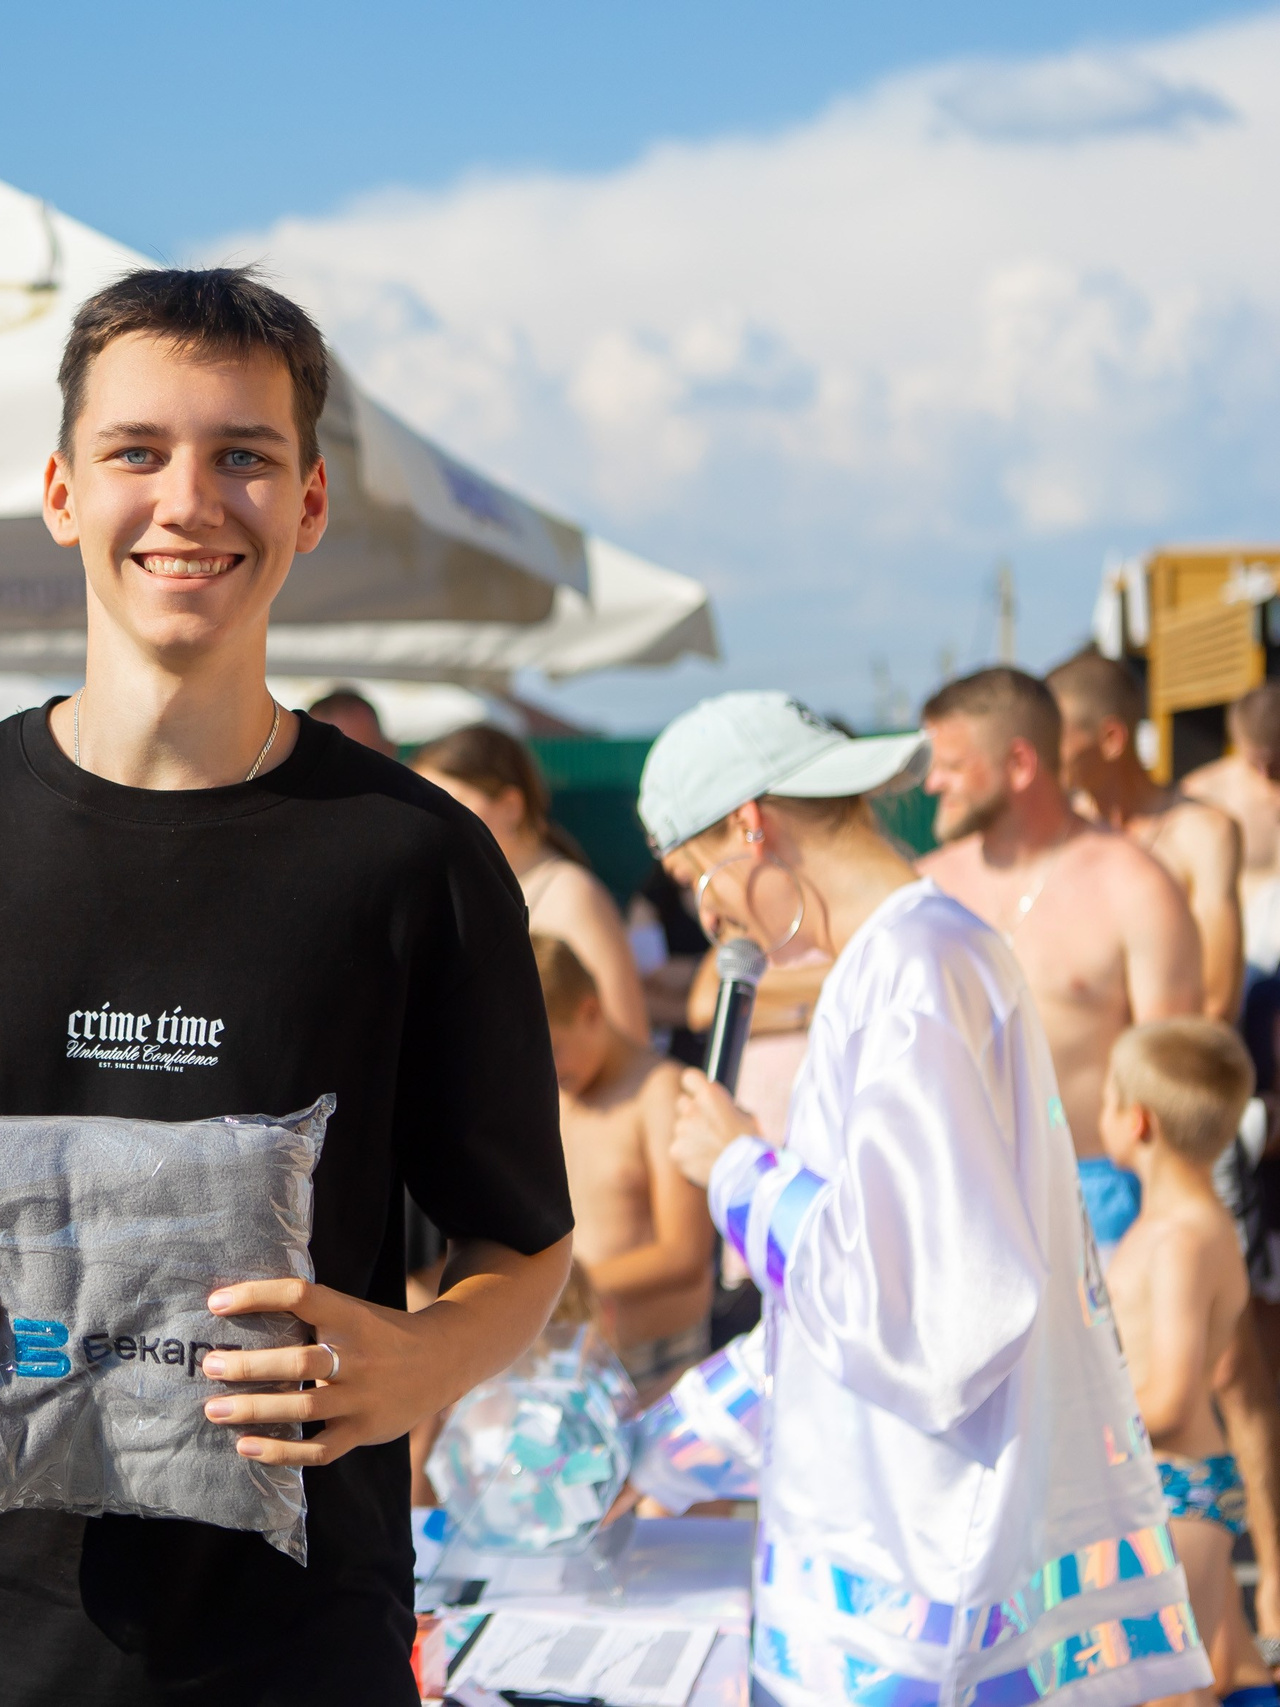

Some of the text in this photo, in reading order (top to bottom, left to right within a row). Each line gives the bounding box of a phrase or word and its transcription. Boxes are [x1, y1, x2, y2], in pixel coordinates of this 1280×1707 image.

[66, 1040, 219, 1069] Unbeatable Confidence
[98, 1061, 113, 1069] EST.
[114, 1062, 135, 1070] SINCE
[136, 1063, 164, 1071] NINETY
